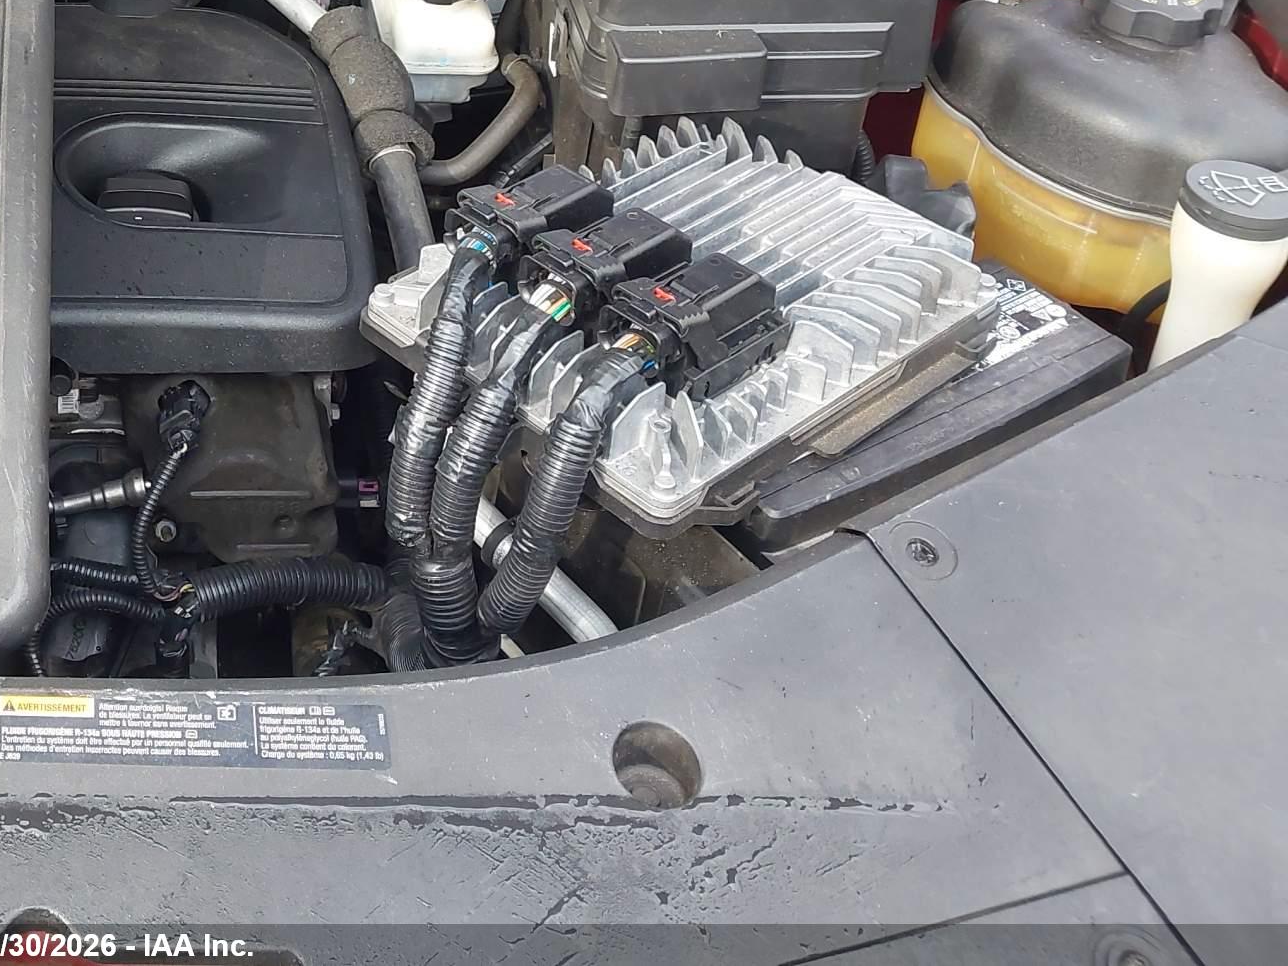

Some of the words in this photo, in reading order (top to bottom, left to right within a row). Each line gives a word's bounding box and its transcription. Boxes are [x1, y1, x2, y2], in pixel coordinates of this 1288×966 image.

[17, 703, 86, 712] AVERTISSEMENT
[259, 706, 305, 715] CLIMATISEUR
[1, 727, 26, 735] FLUIDE
[102, 729, 120, 737] SOUS
[146, 730, 181, 739] PRESSION
